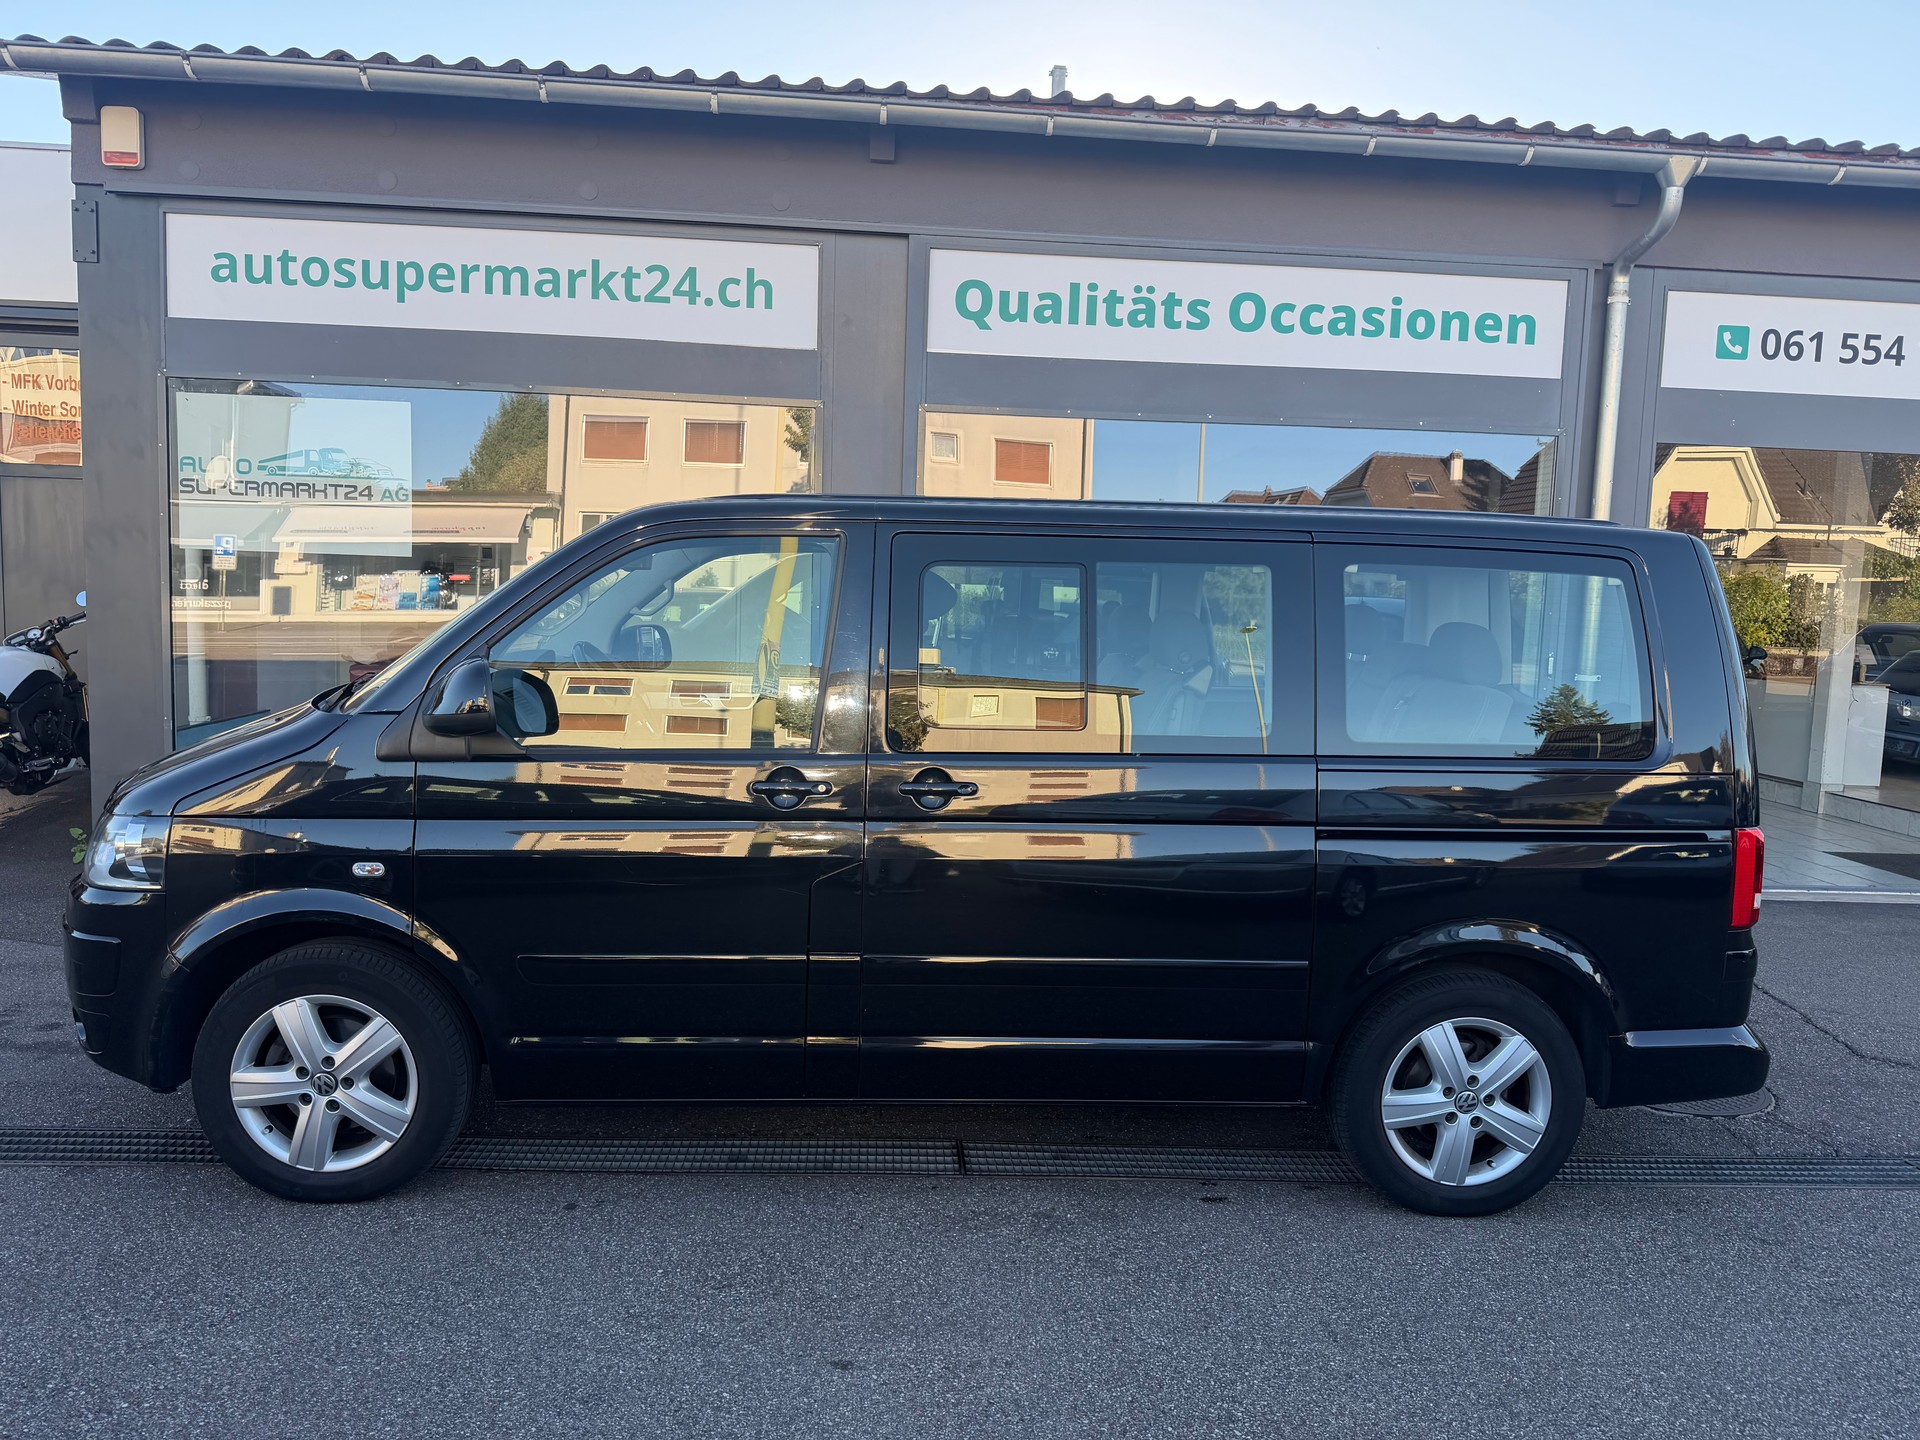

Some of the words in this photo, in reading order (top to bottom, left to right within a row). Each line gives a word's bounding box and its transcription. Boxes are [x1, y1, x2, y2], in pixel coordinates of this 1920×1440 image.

[211, 249, 773, 310] autosupermarkt24.ch
[954, 279, 1211, 331] Qualitäts
[1228, 292, 1537, 345] Occasionen
[1760, 328, 1824, 362] 061
[1838, 332, 1905, 366] 554
[11, 373, 42, 389] MFK
[45, 374, 81, 391] Vorb
[12, 400, 56, 416] Winter
[60, 401, 81, 417] So
[180, 455, 252, 474] AUO
[380, 487, 409, 502] AG
